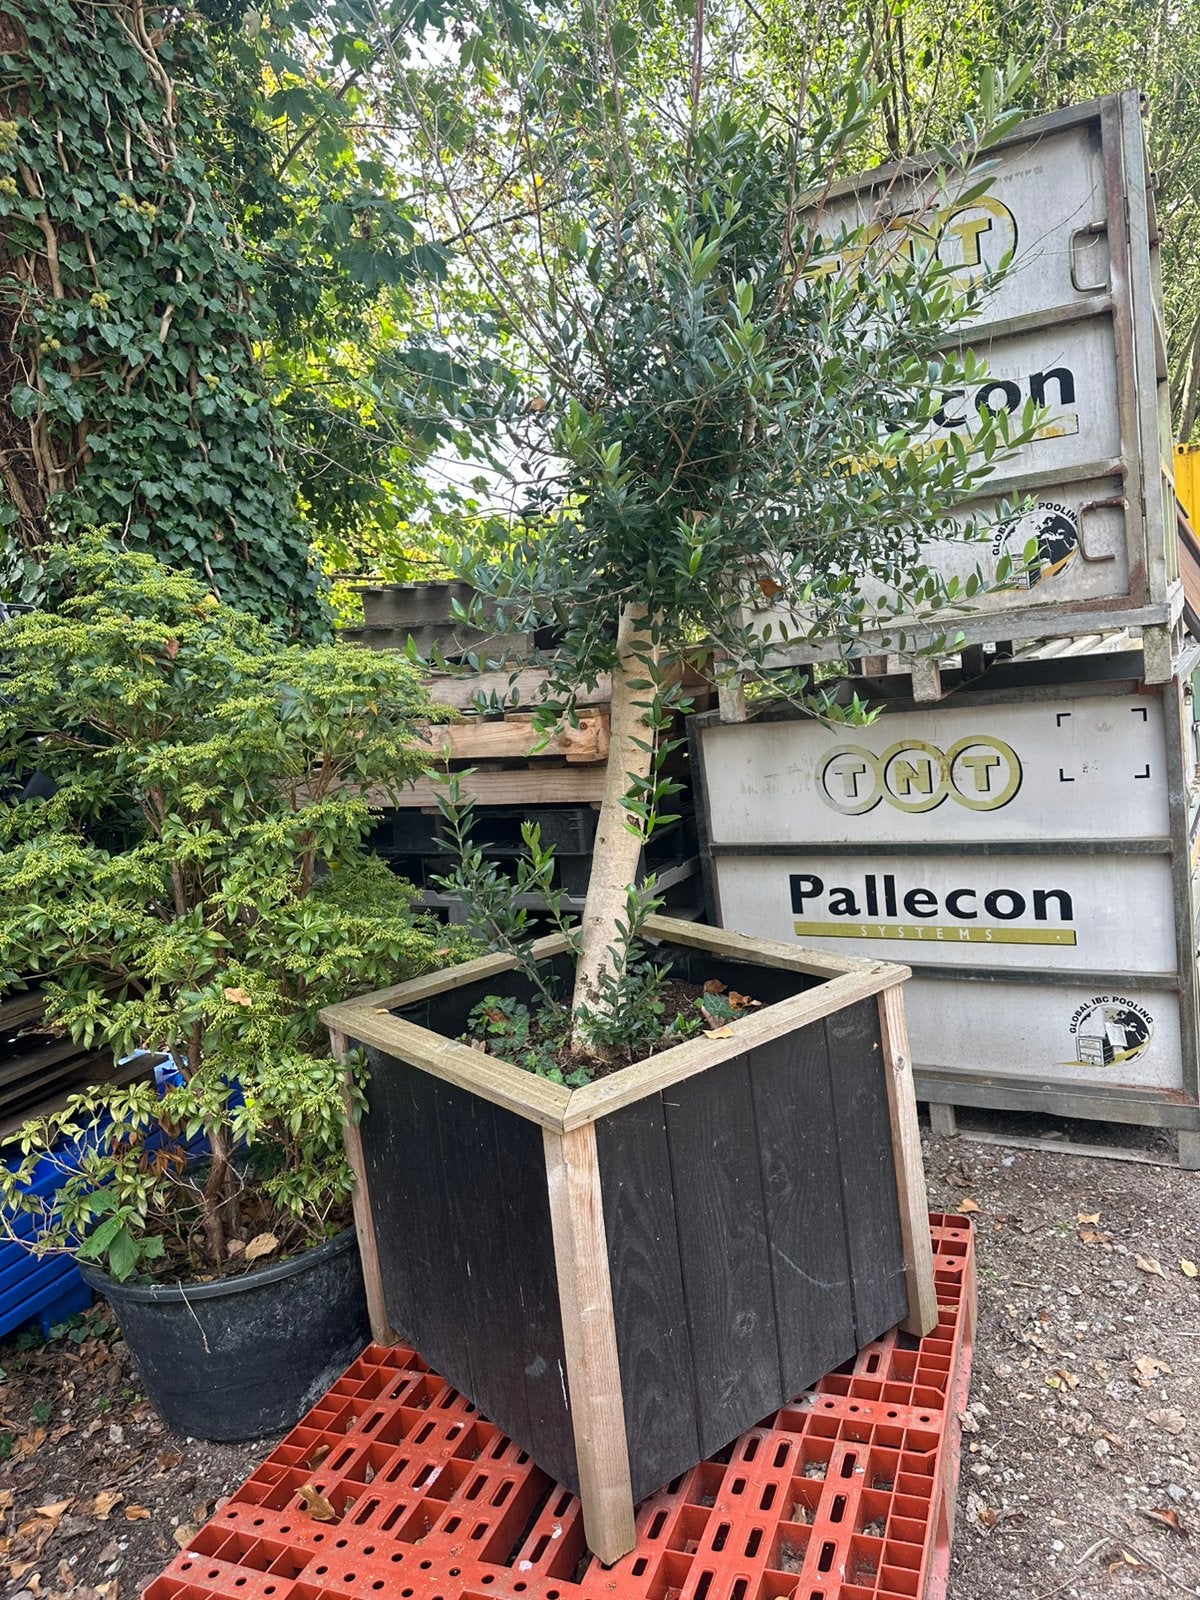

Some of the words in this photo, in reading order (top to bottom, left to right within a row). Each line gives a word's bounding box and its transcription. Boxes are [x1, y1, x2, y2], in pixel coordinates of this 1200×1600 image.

[831, 754, 1001, 798] TNT
[788, 874, 1074, 921] Pallecon
[860, 924, 993, 940] SYSTEMS
[1069, 1002, 1091, 1033] GLOBAL
[1091, 995, 1109, 1005] IBC
[1112, 995, 1154, 1024] POOLING
